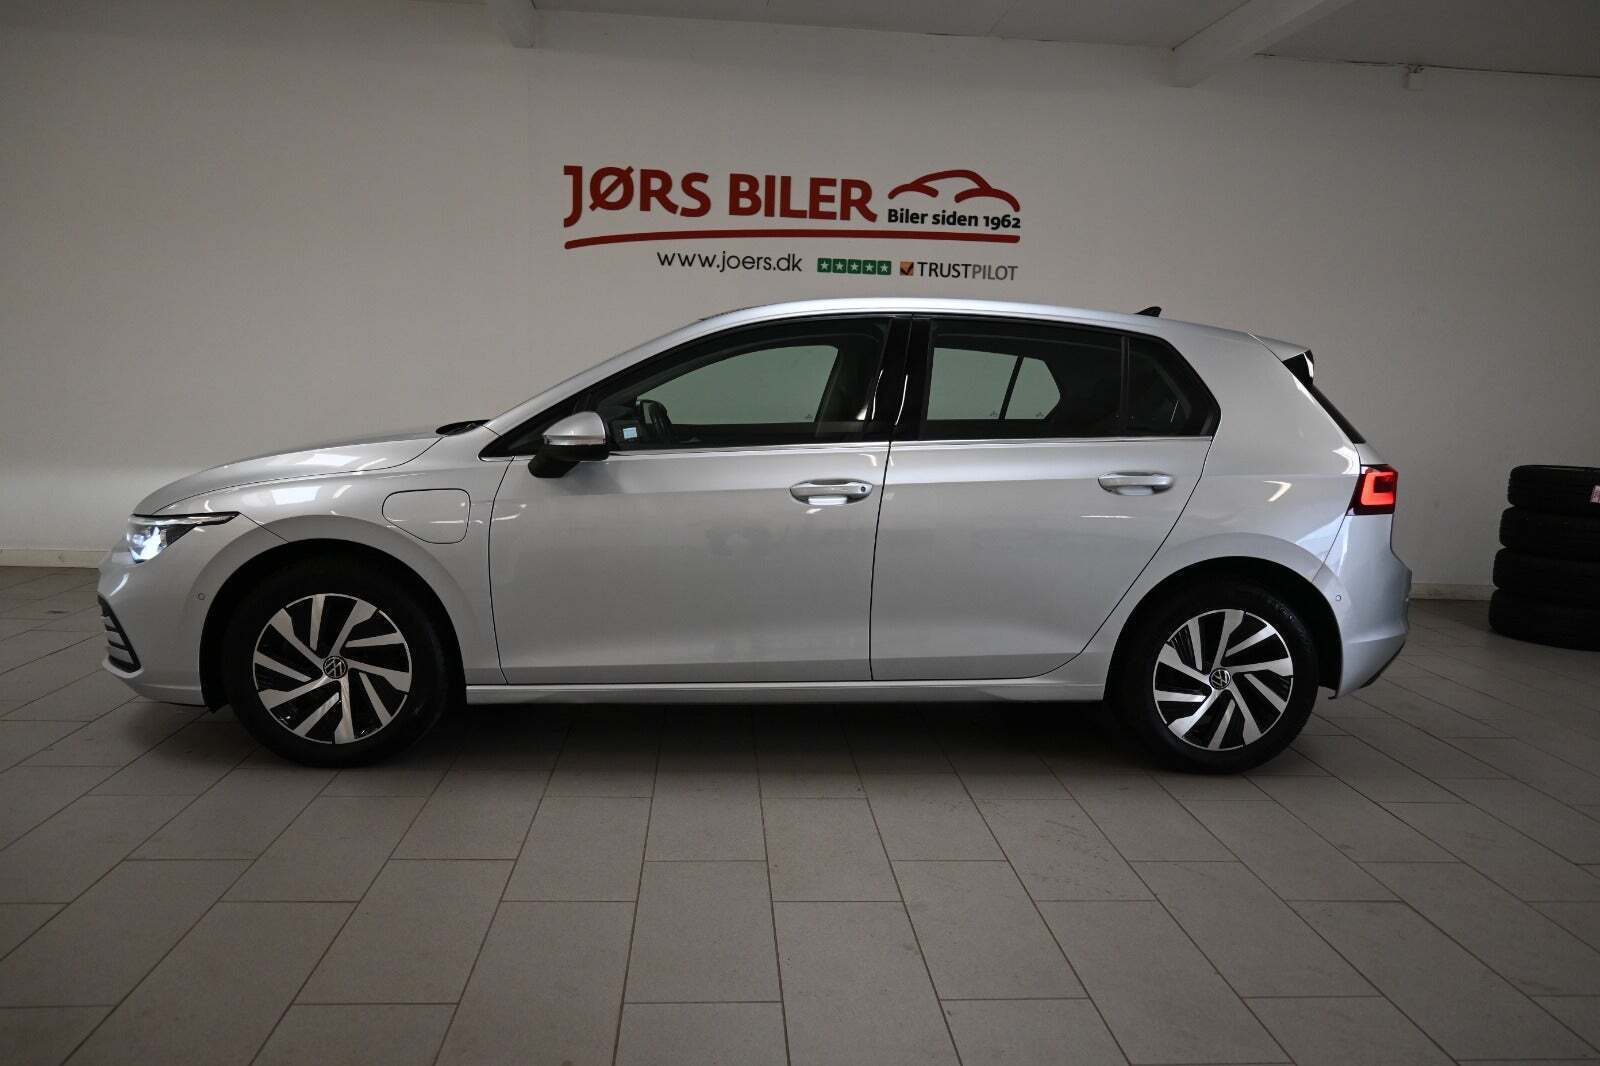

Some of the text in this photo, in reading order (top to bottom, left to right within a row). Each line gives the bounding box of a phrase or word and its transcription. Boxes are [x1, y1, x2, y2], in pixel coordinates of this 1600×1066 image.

[563, 165, 878, 228] JØRS BILER
[888, 208, 1021, 230] Biler siden 1962
[657, 251, 803, 273] www.joers.dk
[917, 261, 1018, 281] TRUSTPILOT
